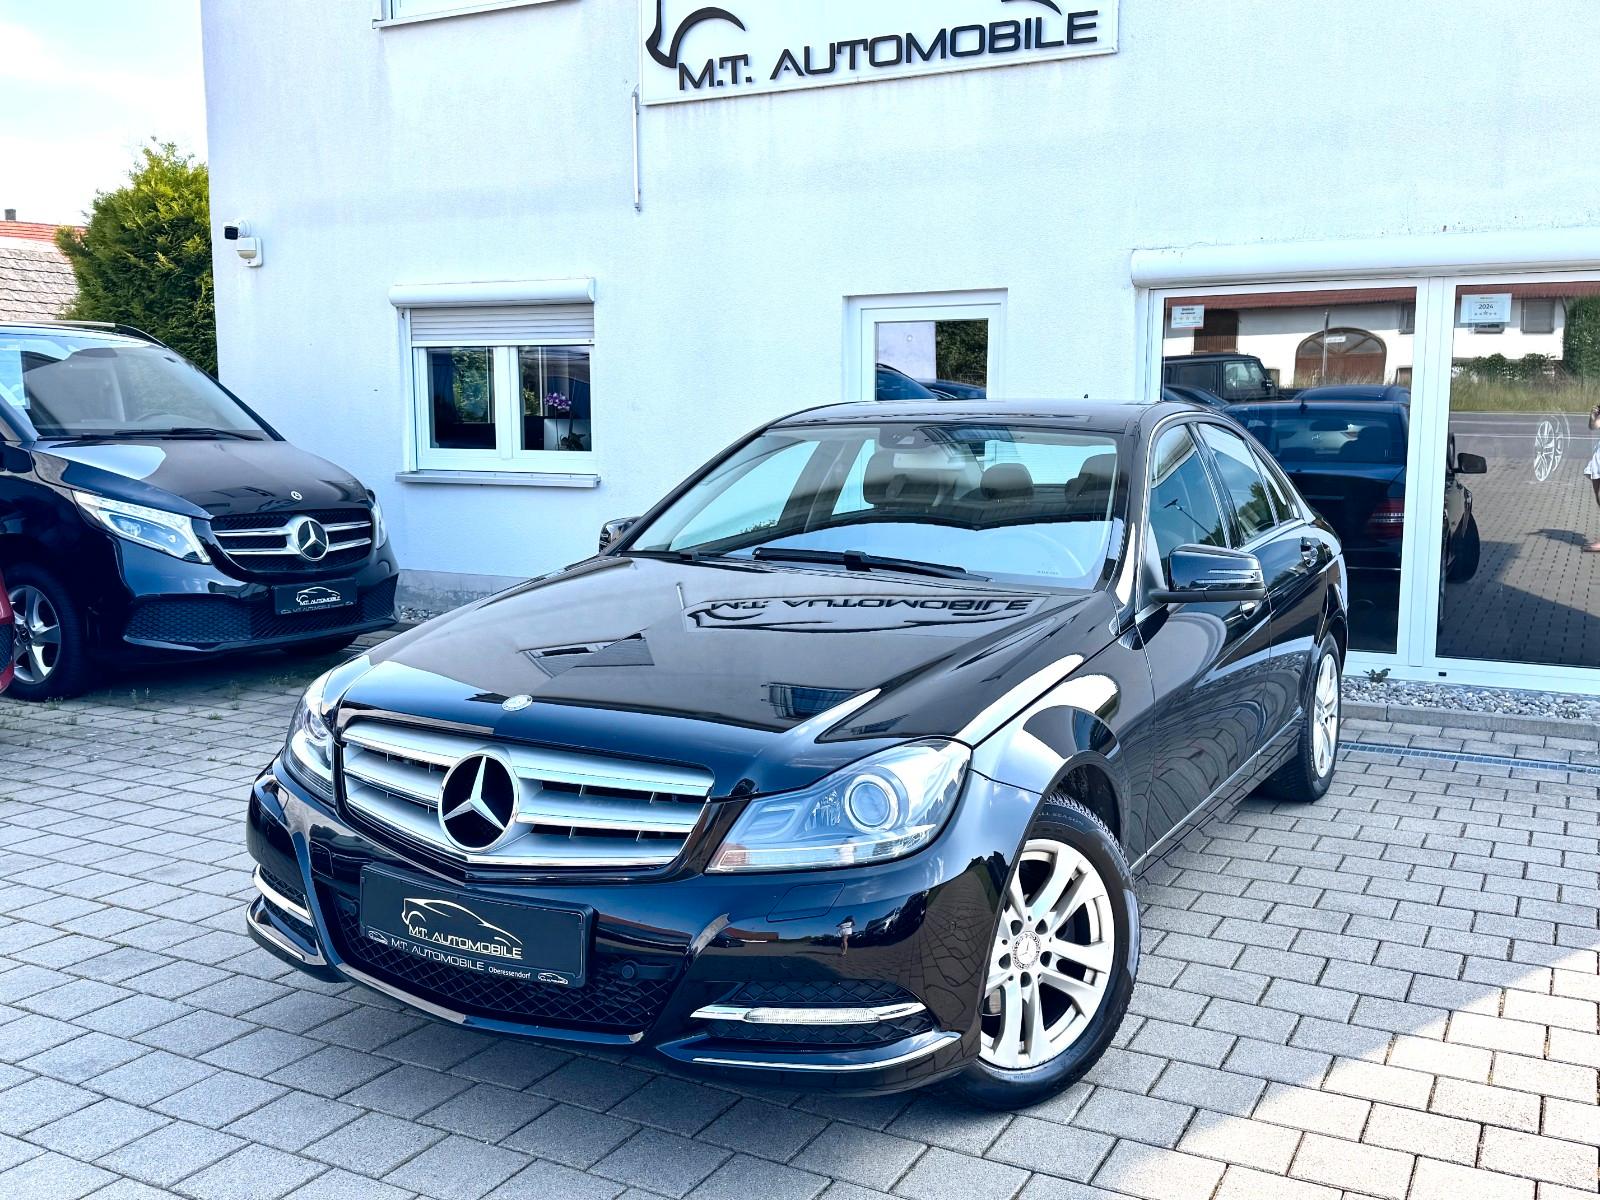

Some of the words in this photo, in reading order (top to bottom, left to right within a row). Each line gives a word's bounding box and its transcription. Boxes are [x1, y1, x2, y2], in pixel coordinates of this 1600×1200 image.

[677, 53, 754, 91] M.T.
[769, 10, 1099, 80] AUTOMOBILE
[391, 937, 409, 952] M.T.
[411, 945, 485, 971] AUTOMOBILE
[488, 966, 532, 980] Oberessendorf
[408, 923, 428, 940] M.T.
[432, 931, 522, 959] AUTOMOBILE
